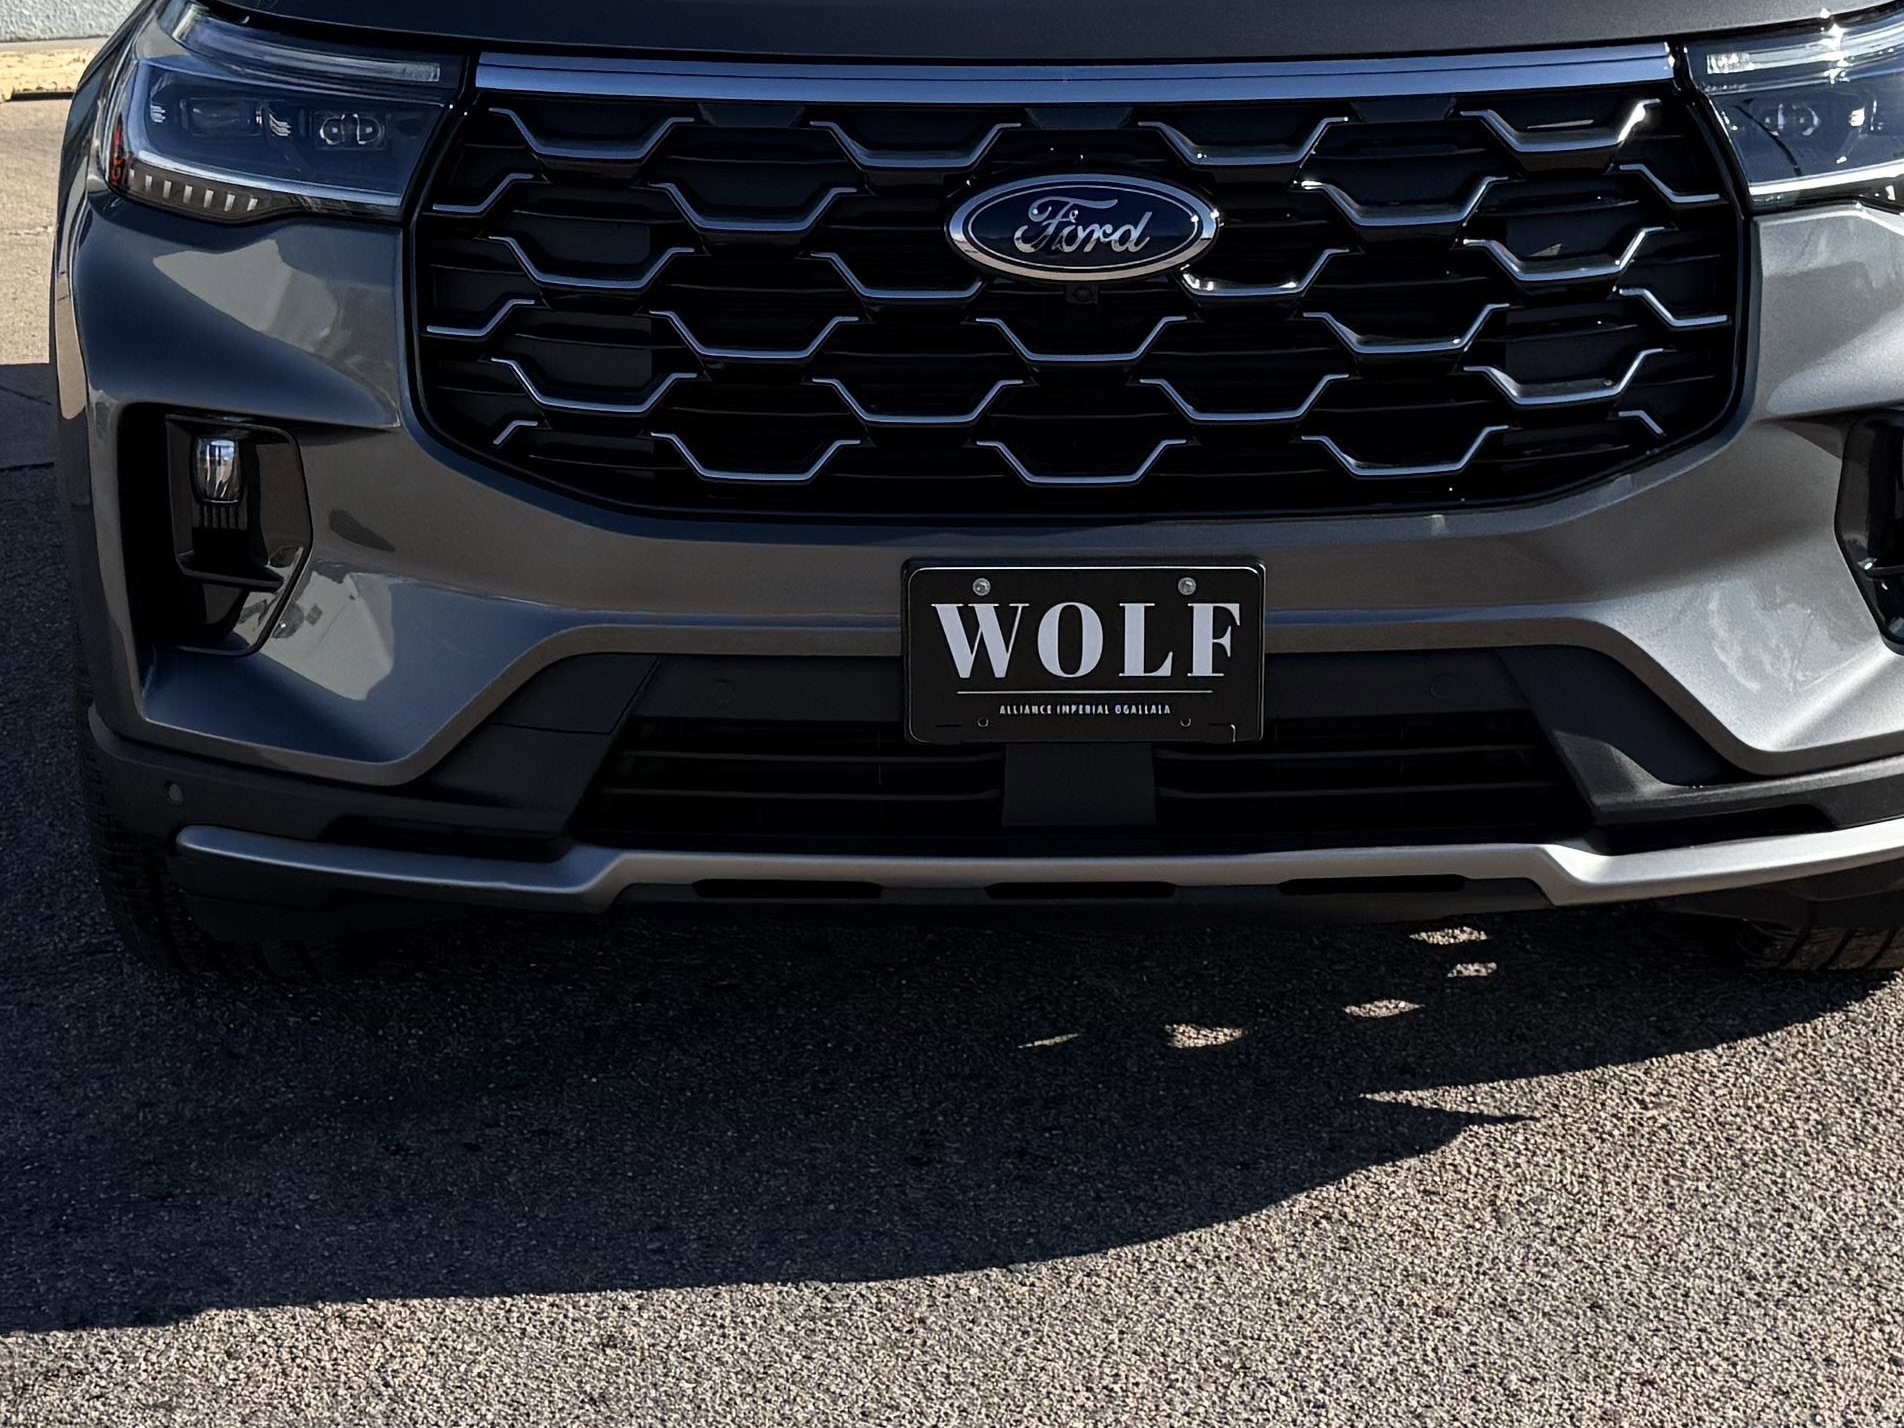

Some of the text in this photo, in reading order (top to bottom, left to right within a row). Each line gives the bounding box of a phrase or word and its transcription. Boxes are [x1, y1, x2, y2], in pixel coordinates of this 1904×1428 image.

[1014, 195, 1153, 253] Ford
[931, 602, 1241, 679] WOLF
[999, 704, 1052, 715] ALLIANCE
[1114, 704, 1171, 715] OGALLALA
